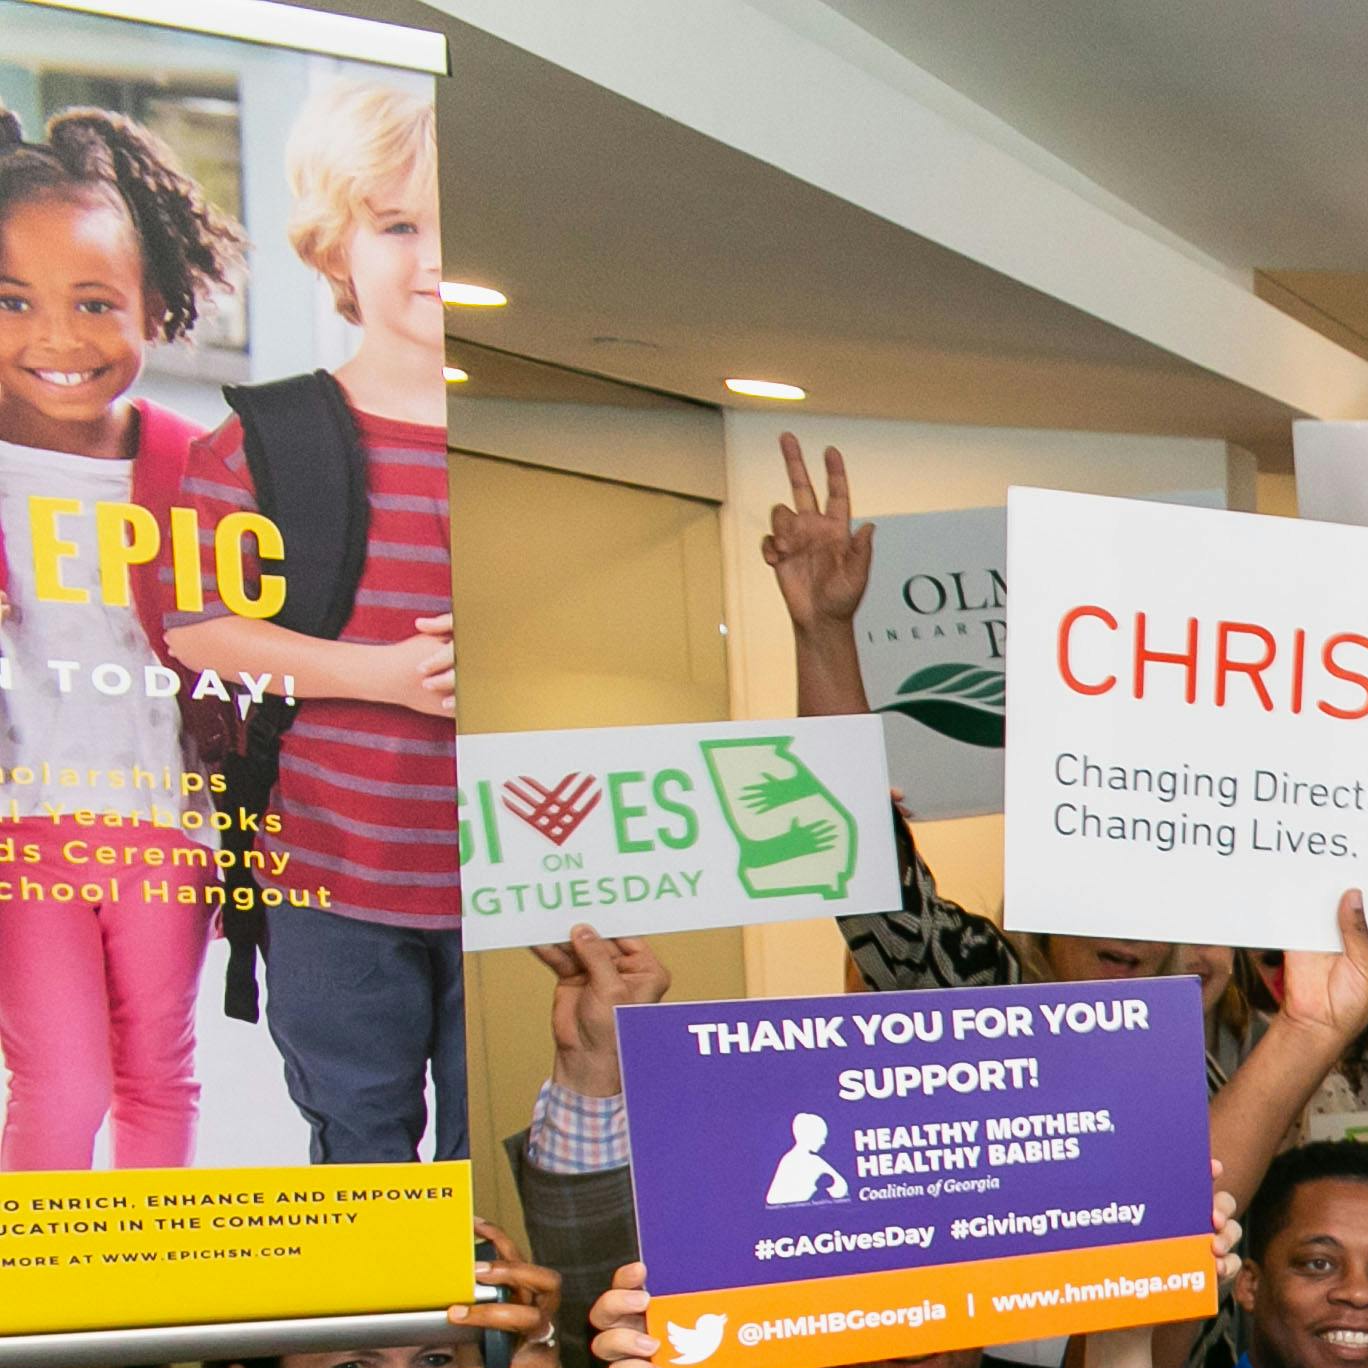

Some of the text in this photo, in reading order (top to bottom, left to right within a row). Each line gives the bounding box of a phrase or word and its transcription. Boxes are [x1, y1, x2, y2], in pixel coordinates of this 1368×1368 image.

[28, 495, 287, 619] EPIC
[867, 621, 968, 644] INEAR
[48, 659, 296, 706] TODAY!
[1054, 752, 1240, 807] Changing
[43, 799, 282, 832] Yearbooks
[1054, 803, 1359, 859] Changing Lives.
[63, 840, 290, 876] Ceremony
[543, 851, 584, 873] ON
[0, 876, 332, 911] chool Hangout
[461, 869, 704, 918] GTUESDAY
[688, 998, 1149, 1057] THANK YOU FOR YOUR
[837, 1057, 1041, 1101] SUPPORT!
[853, 1108, 1116, 1152] HEALTHY MOTHERS,
[856, 1136, 1081, 1178] HEALTHY BABIES
[2, 1201, 20, 1213] O
[147, 1191, 266, 1208] ENHANCE
[275, 1189, 326, 1204] AND
[336, 1186, 455, 1203] EMPOWER
[858, 1174, 1001, 1203] Coalition of Georgia
[119, 1218, 144, 1233] IN
[154, 1216, 203, 1231] THE
[212, 1212, 361, 1230] COMMUNITY
[755, 1202, 1147, 1262] #GAGivesDay #GivingTuesday
[2, 1256, 60, 1269] MORE
[69, 1254, 94, 1267] AT
[737, 1268, 1206, 1348] @HMHBGeorgia www.hmhbga.org
